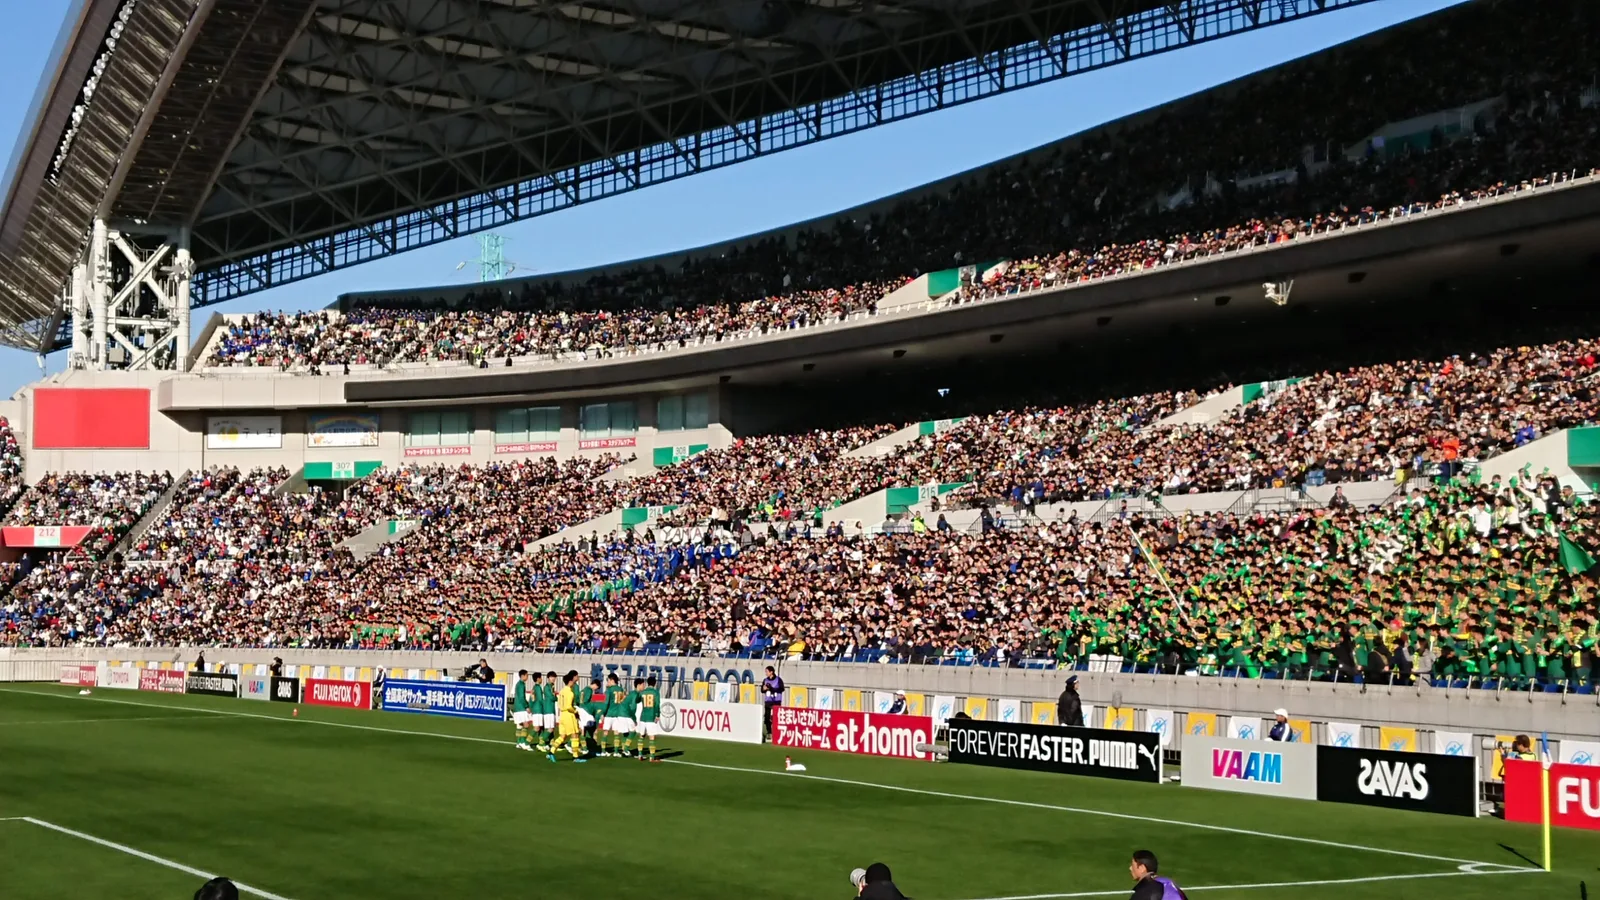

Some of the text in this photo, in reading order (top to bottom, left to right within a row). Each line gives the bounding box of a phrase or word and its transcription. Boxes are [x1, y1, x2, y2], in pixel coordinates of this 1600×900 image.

[335, 461, 351, 470] 307
[920, 486, 936, 499] 215
[39, 528, 56, 537] 212
[313, 684, 328, 701] FUJI
[641, 694, 655, 708] 18
[680, 708, 732, 733] TOYOTA
[777, 708, 832, 729] 住まいさがしは
[777, 725, 832, 749] アットホーム
[949, 728, 1019, 759] FOREVER
[1212, 748, 1283, 785] VAAM
[1358, 758, 1429, 801] SAVAS
